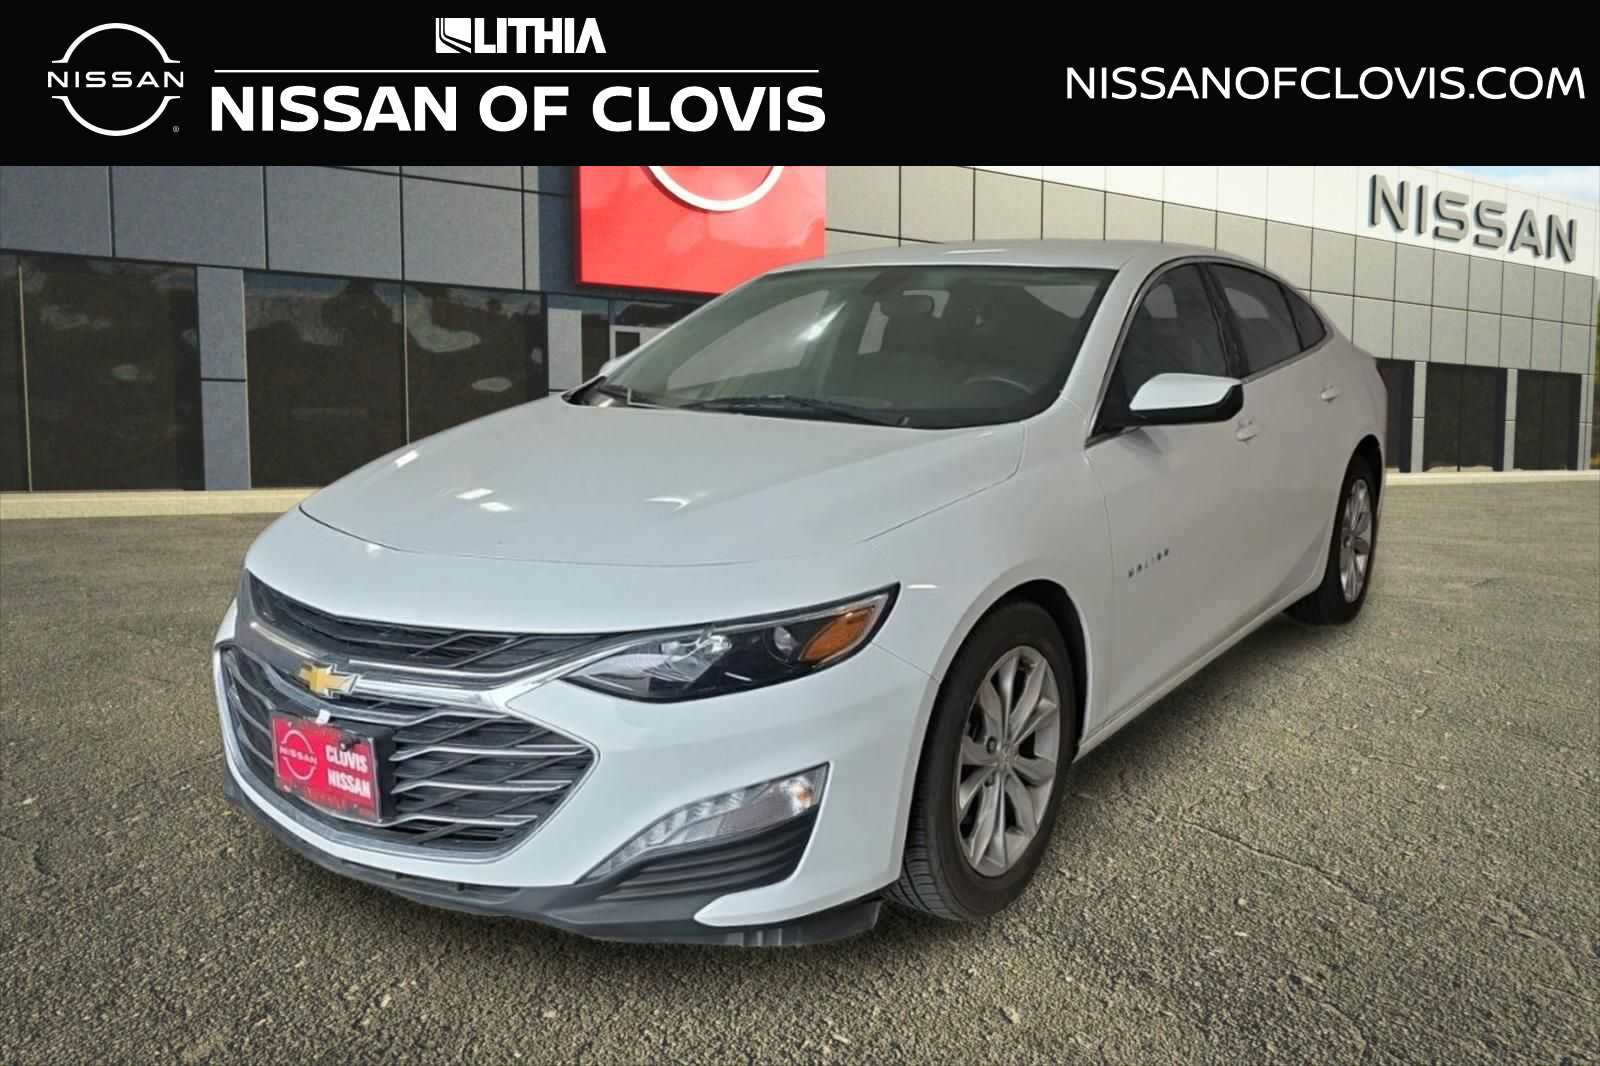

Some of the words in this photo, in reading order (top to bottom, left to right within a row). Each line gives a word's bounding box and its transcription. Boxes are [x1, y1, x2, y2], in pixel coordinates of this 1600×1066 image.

[1368, 174, 1578, 263] NISSAN
[325, 744, 369, 773] CLOVIS
[327, 768, 371, 799] NISSAN
